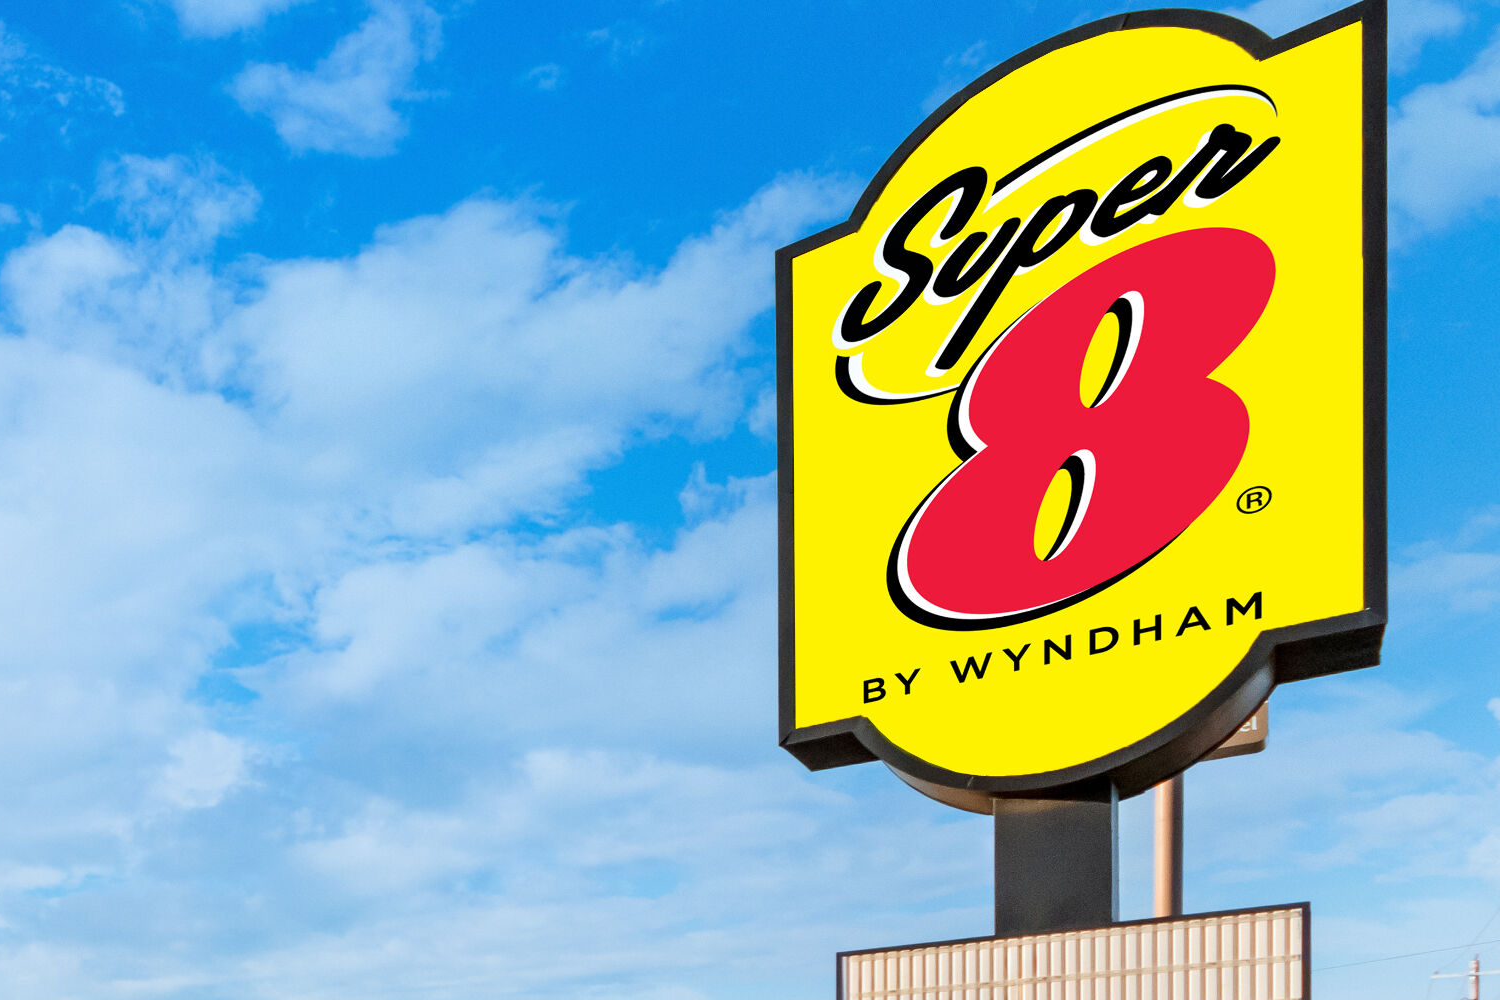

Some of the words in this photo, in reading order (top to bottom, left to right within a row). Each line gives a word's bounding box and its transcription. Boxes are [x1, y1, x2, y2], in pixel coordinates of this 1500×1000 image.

[833, 122, 1281, 374] Super
[886, 227, 1277, 632] 8
[863, 667, 921, 704] BY
[950, 591, 1263, 684] WYNDHAM
